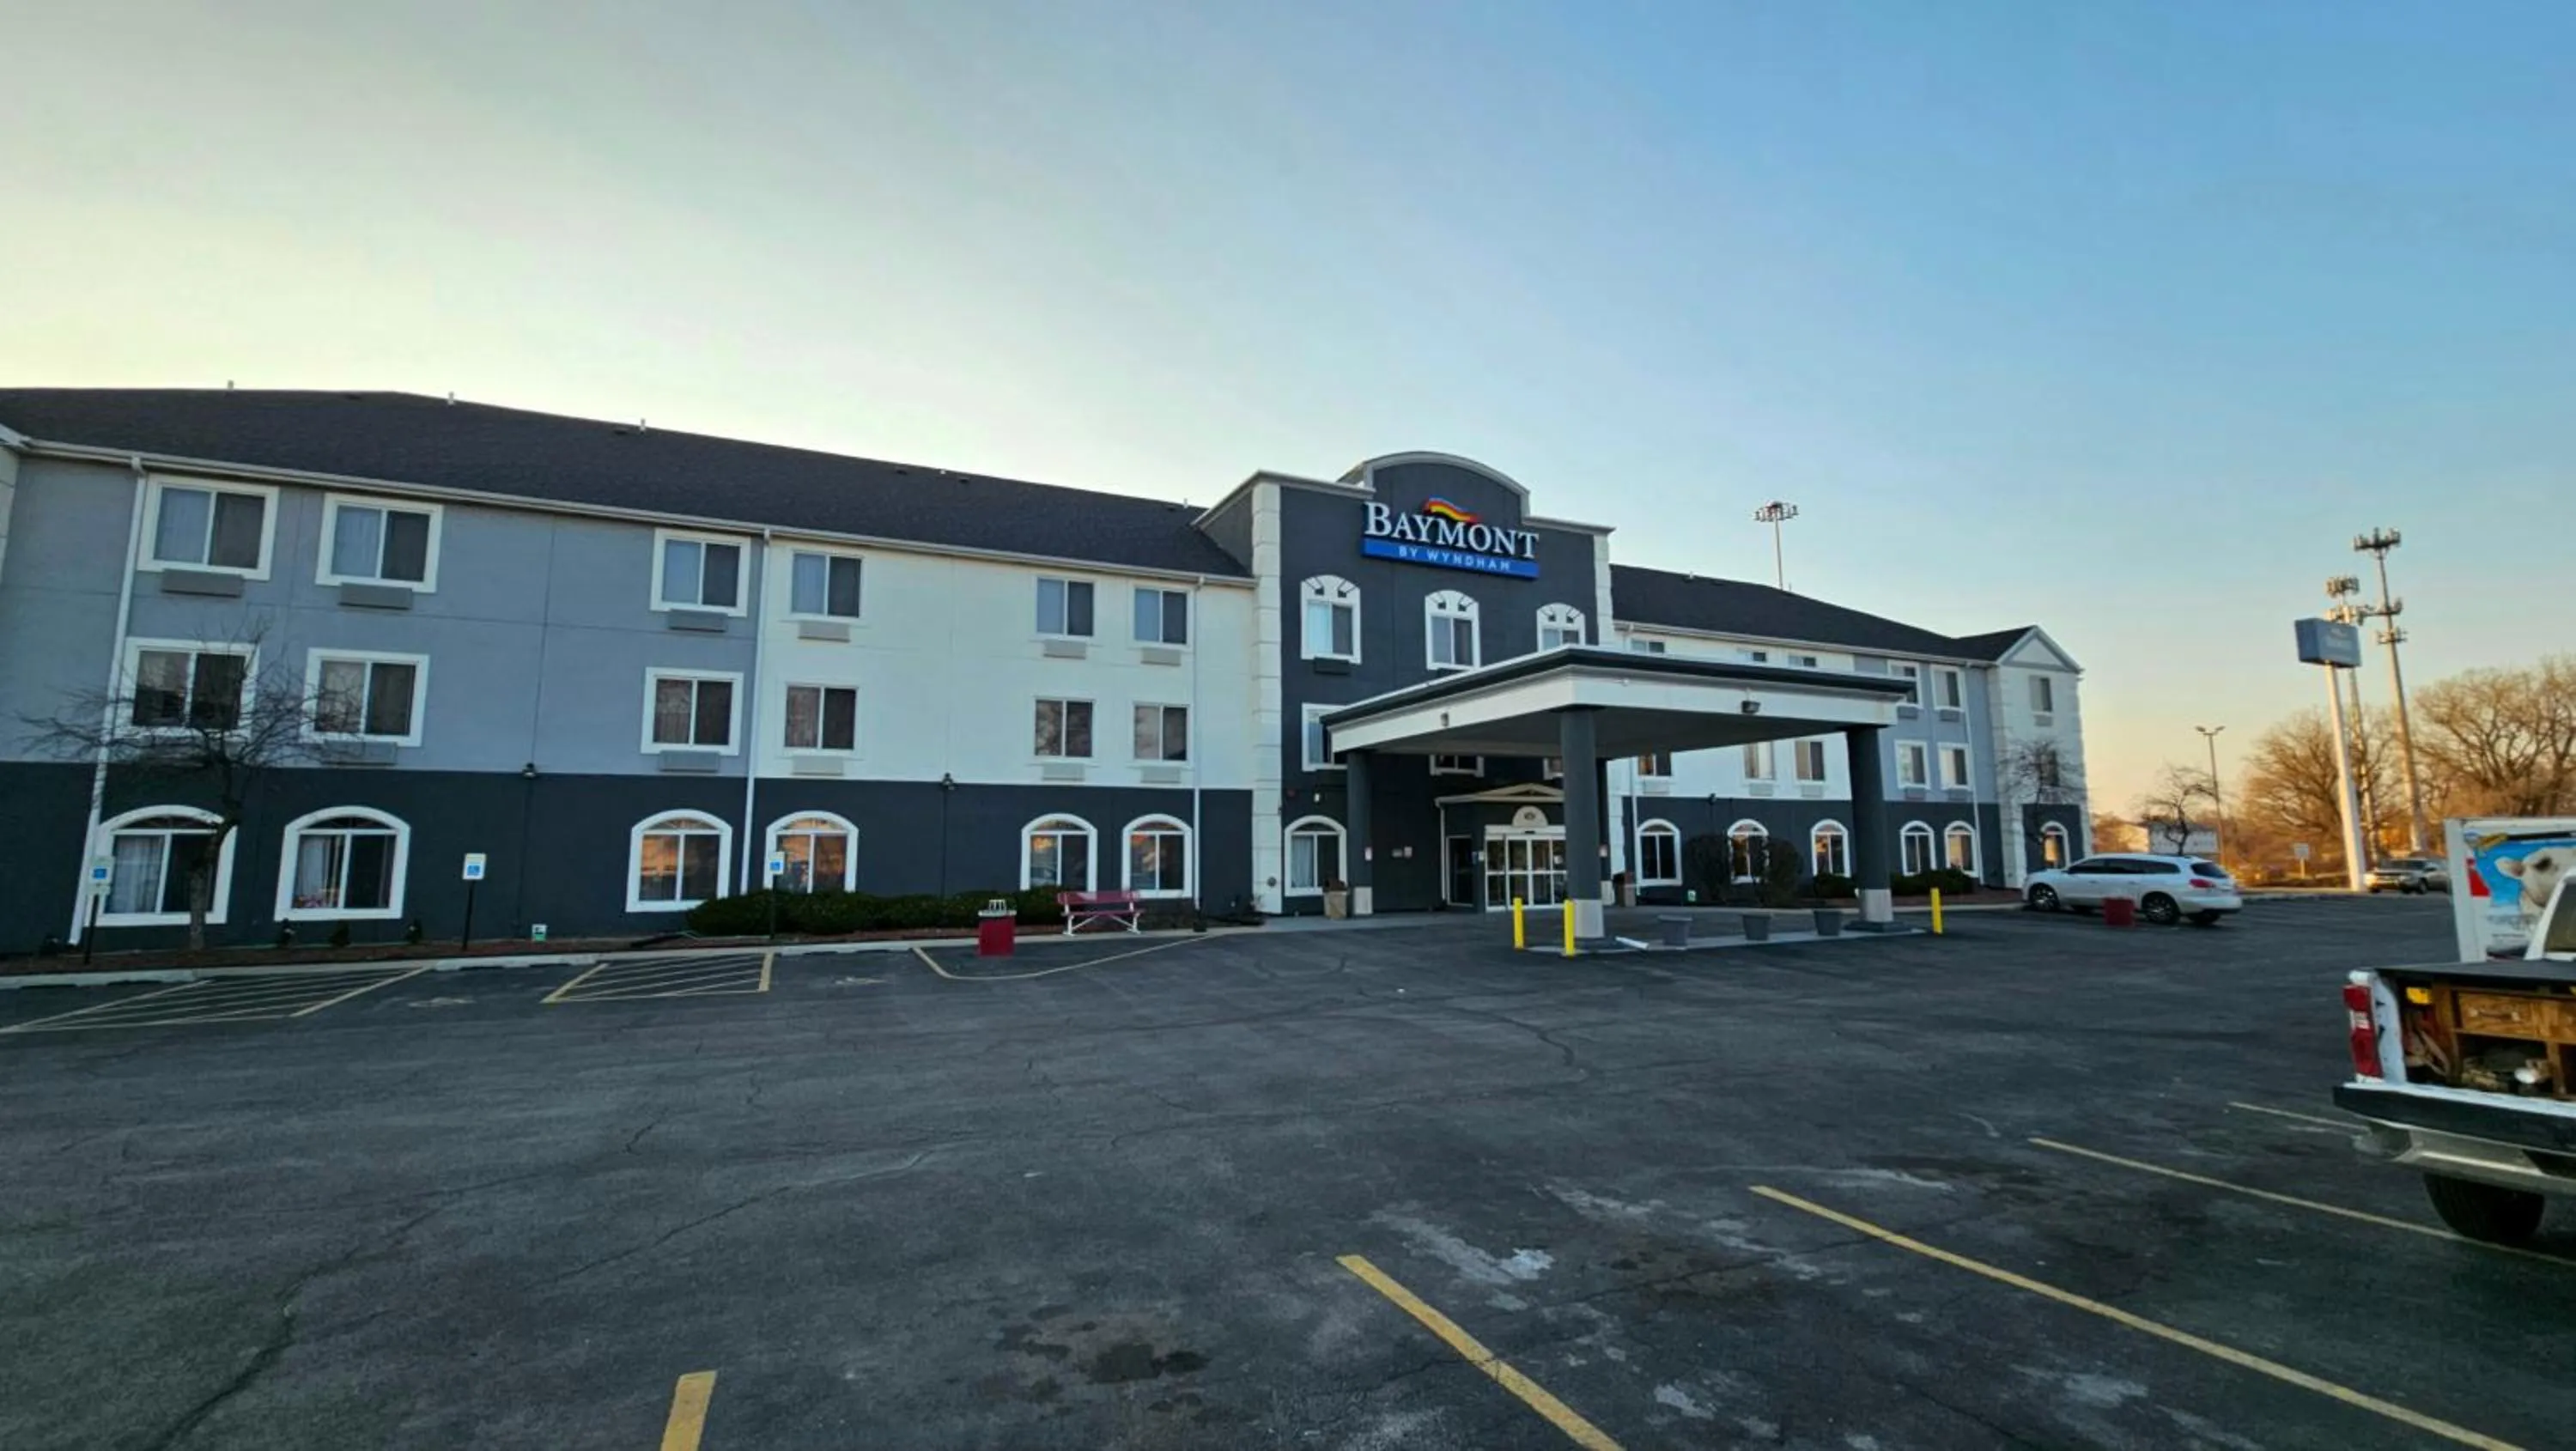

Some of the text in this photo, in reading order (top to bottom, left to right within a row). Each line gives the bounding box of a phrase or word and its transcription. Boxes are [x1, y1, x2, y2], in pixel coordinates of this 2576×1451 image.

[1364, 501, 1539, 558] BAYMONT
[1398, 545, 1510, 571] BY WYNDHAM
